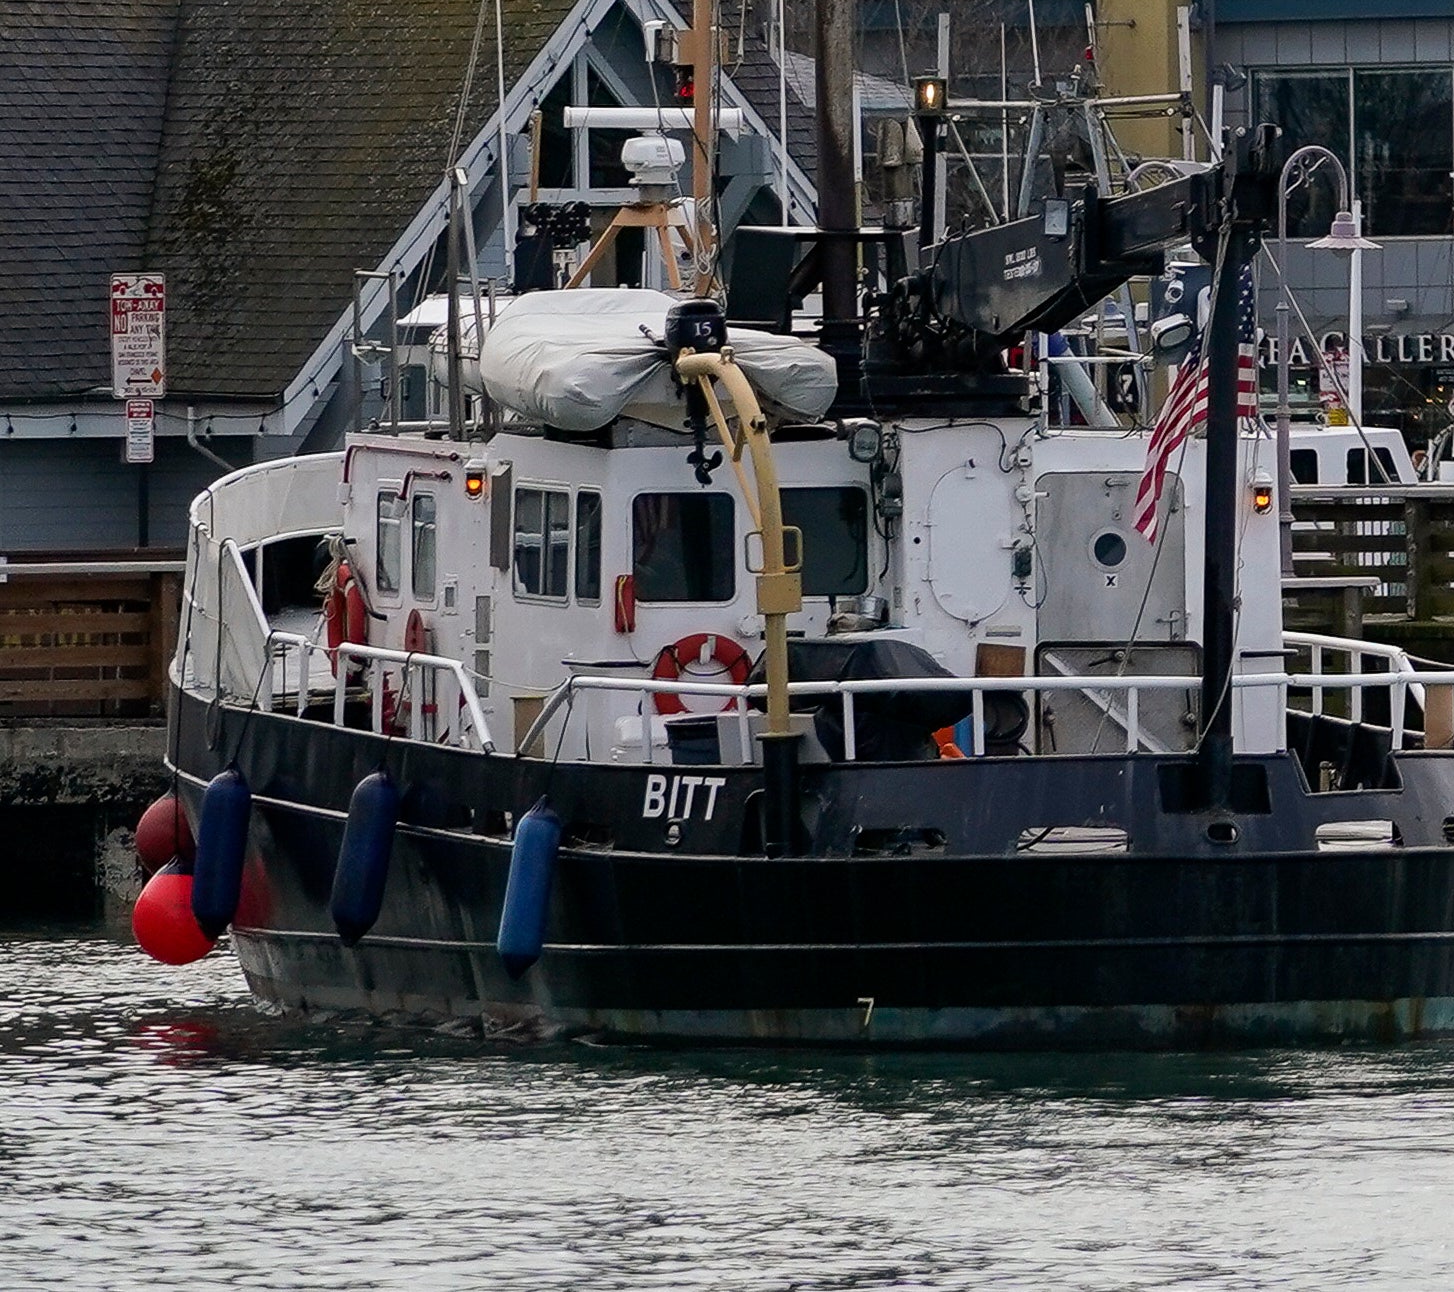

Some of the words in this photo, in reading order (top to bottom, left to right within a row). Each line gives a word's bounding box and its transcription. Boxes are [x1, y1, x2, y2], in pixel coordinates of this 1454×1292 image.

[114, 313, 127, 332] NO
[695, 322, 712, 336] 15
[643, 774, 727, 821] BITT
[857, 997, 875, 1027] 7
